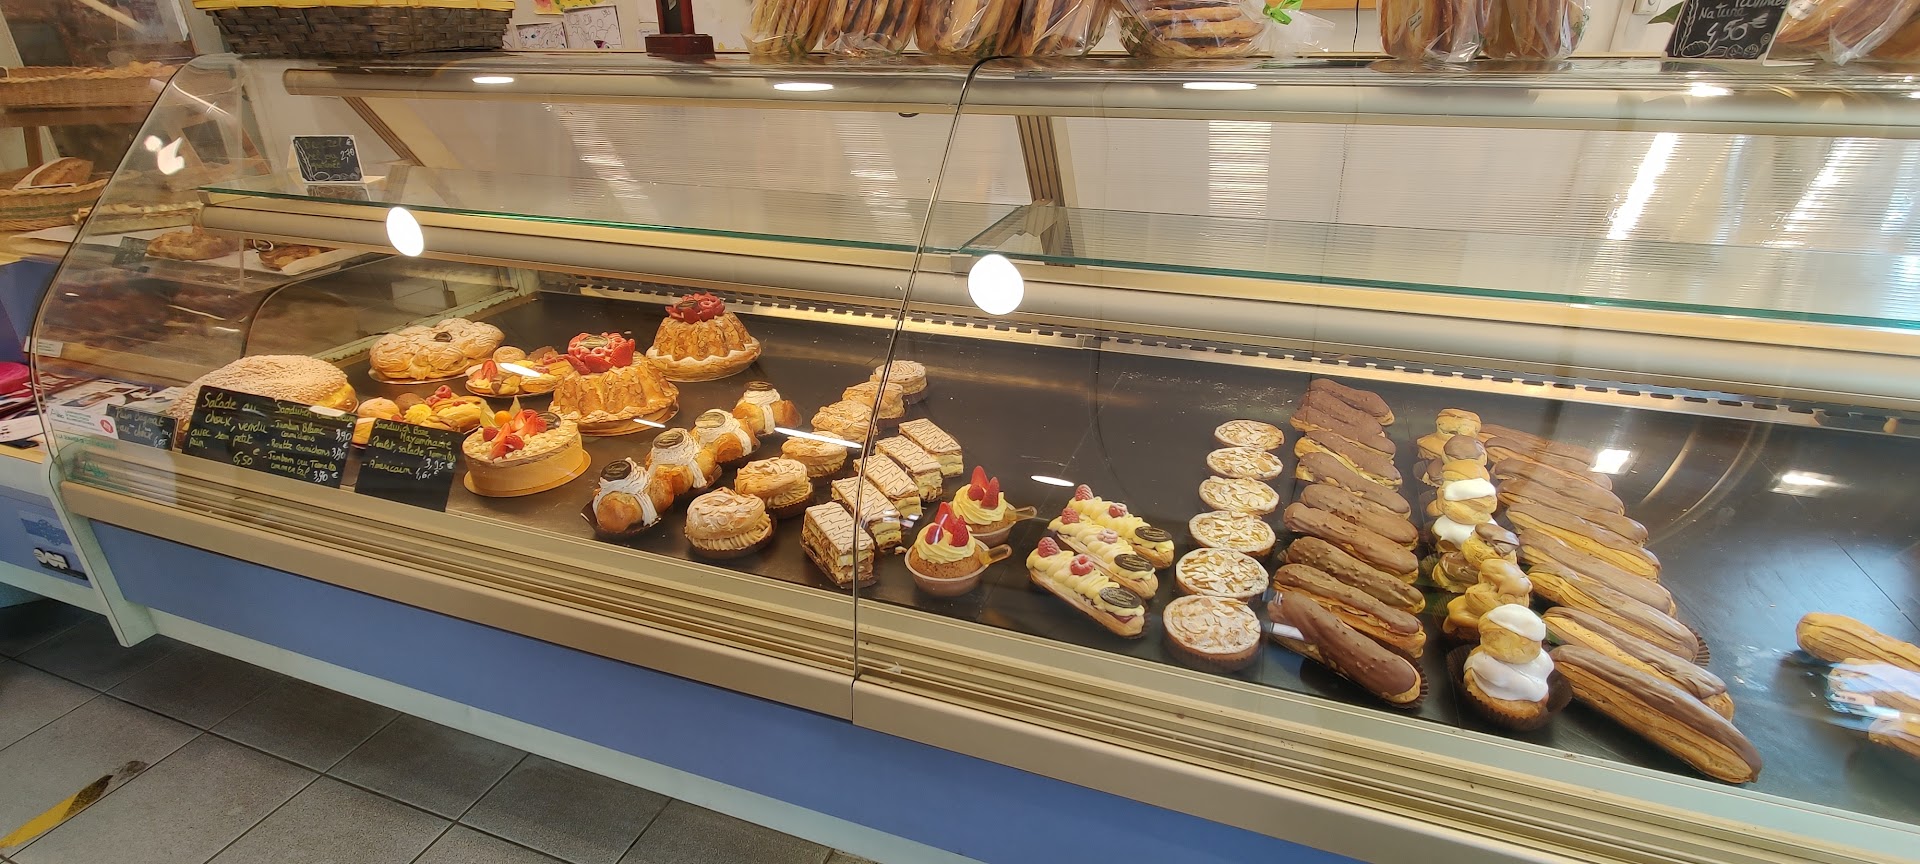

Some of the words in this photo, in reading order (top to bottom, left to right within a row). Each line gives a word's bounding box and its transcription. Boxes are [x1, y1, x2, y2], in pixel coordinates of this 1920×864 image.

[1698, 3, 1748, 20] Nature
[202, 392, 237, 410] Salade
[242, 403, 256, 412] au
[274, 402, 312, 418] Sandwich
[238, 421, 268, 434] vendu
[374, 420, 410, 433] Sandwich
[190, 428, 212, 437] avec
[232, 434, 253, 447] petit
[232, 451, 253, 466] 6,50
